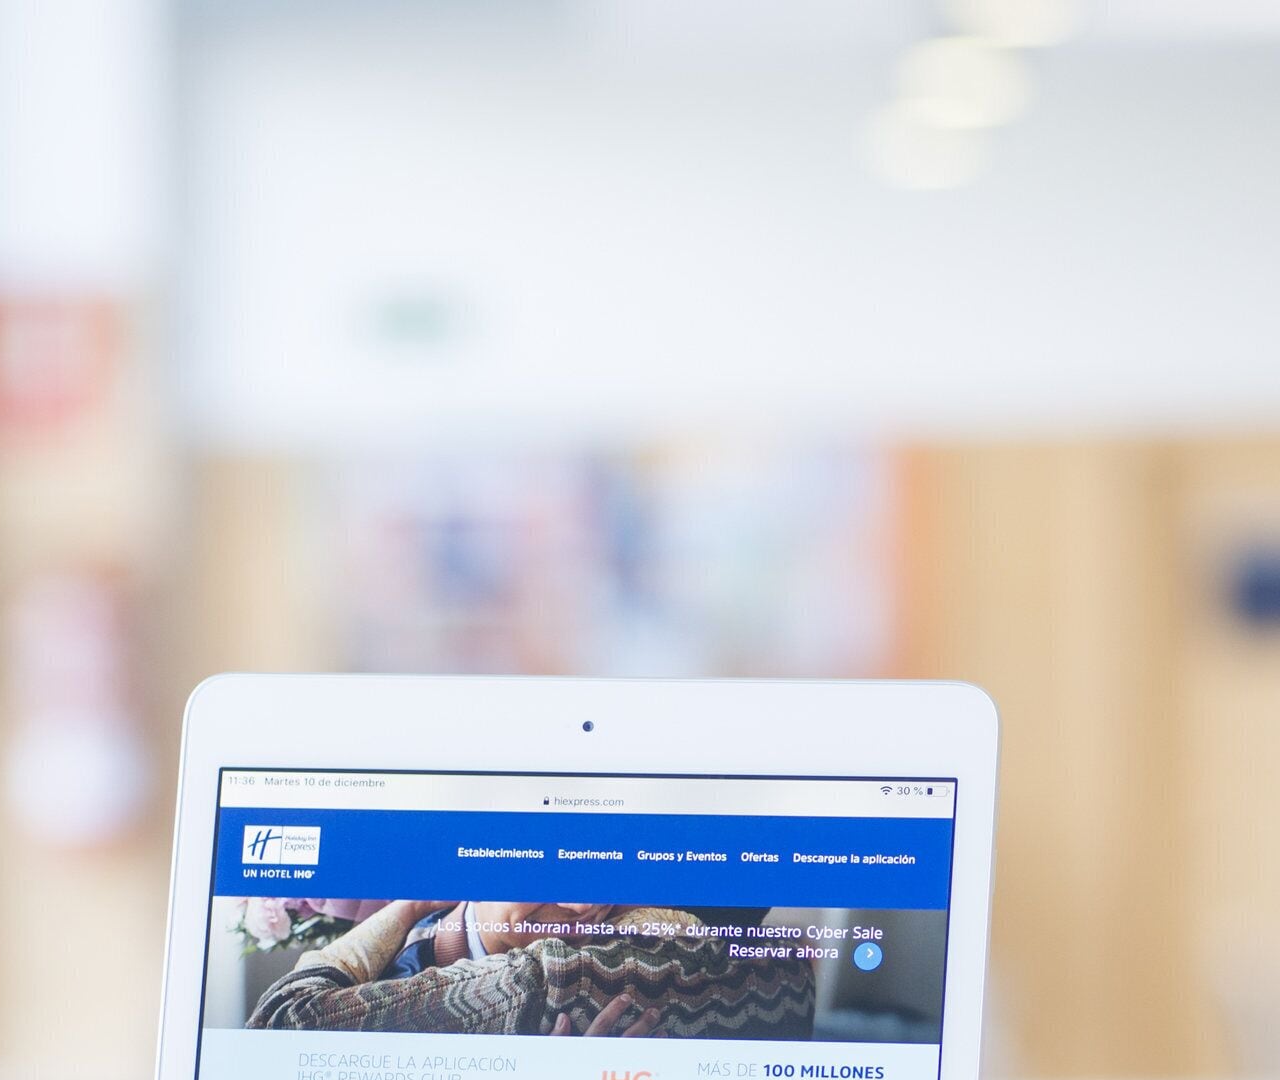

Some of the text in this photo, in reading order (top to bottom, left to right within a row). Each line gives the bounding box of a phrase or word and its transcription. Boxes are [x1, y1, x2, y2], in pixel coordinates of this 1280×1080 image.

[228, 776, 256, 786] 11:36
[264, 777, 386, 788] Martes 10 de diciembre
[896, 786, 924, 796] 30 %
[554, 796, 625, 807] hiexpress.com
[284, 842, 316, 852] Express
[457, 847, 623, 862] Establecimientos Experimenta
[637, 850, 728, 863] Grupos y Eventos
[740, 851, 779, 863] Ofertas
[792, 852, 916, 866] Descargue la aplicación
[243, 869, 257, 878] UN
[260, 869, 291, 878] HOTEL
[437, 918, 461, 932] Los
[465, 920, 510, 933] socios
[513, 920, 571, 934] ahorran
[575, 921, 615, 935] hasta
[619, 924, 637, 936] un
[686, 923, 743, 937] durante
[746, 926, 802, 939] nuestro
[806, 924, 848, 941] Cyber
[852, 925, 883, 939] Sale
[729, 943, 839, 959] Reservar ahora
[298, 1053, 517, 1072] DESCARGUE LA APLICACIÓN
[697, 1060, 885, 1080] MÁS DE 100 MILLONES
